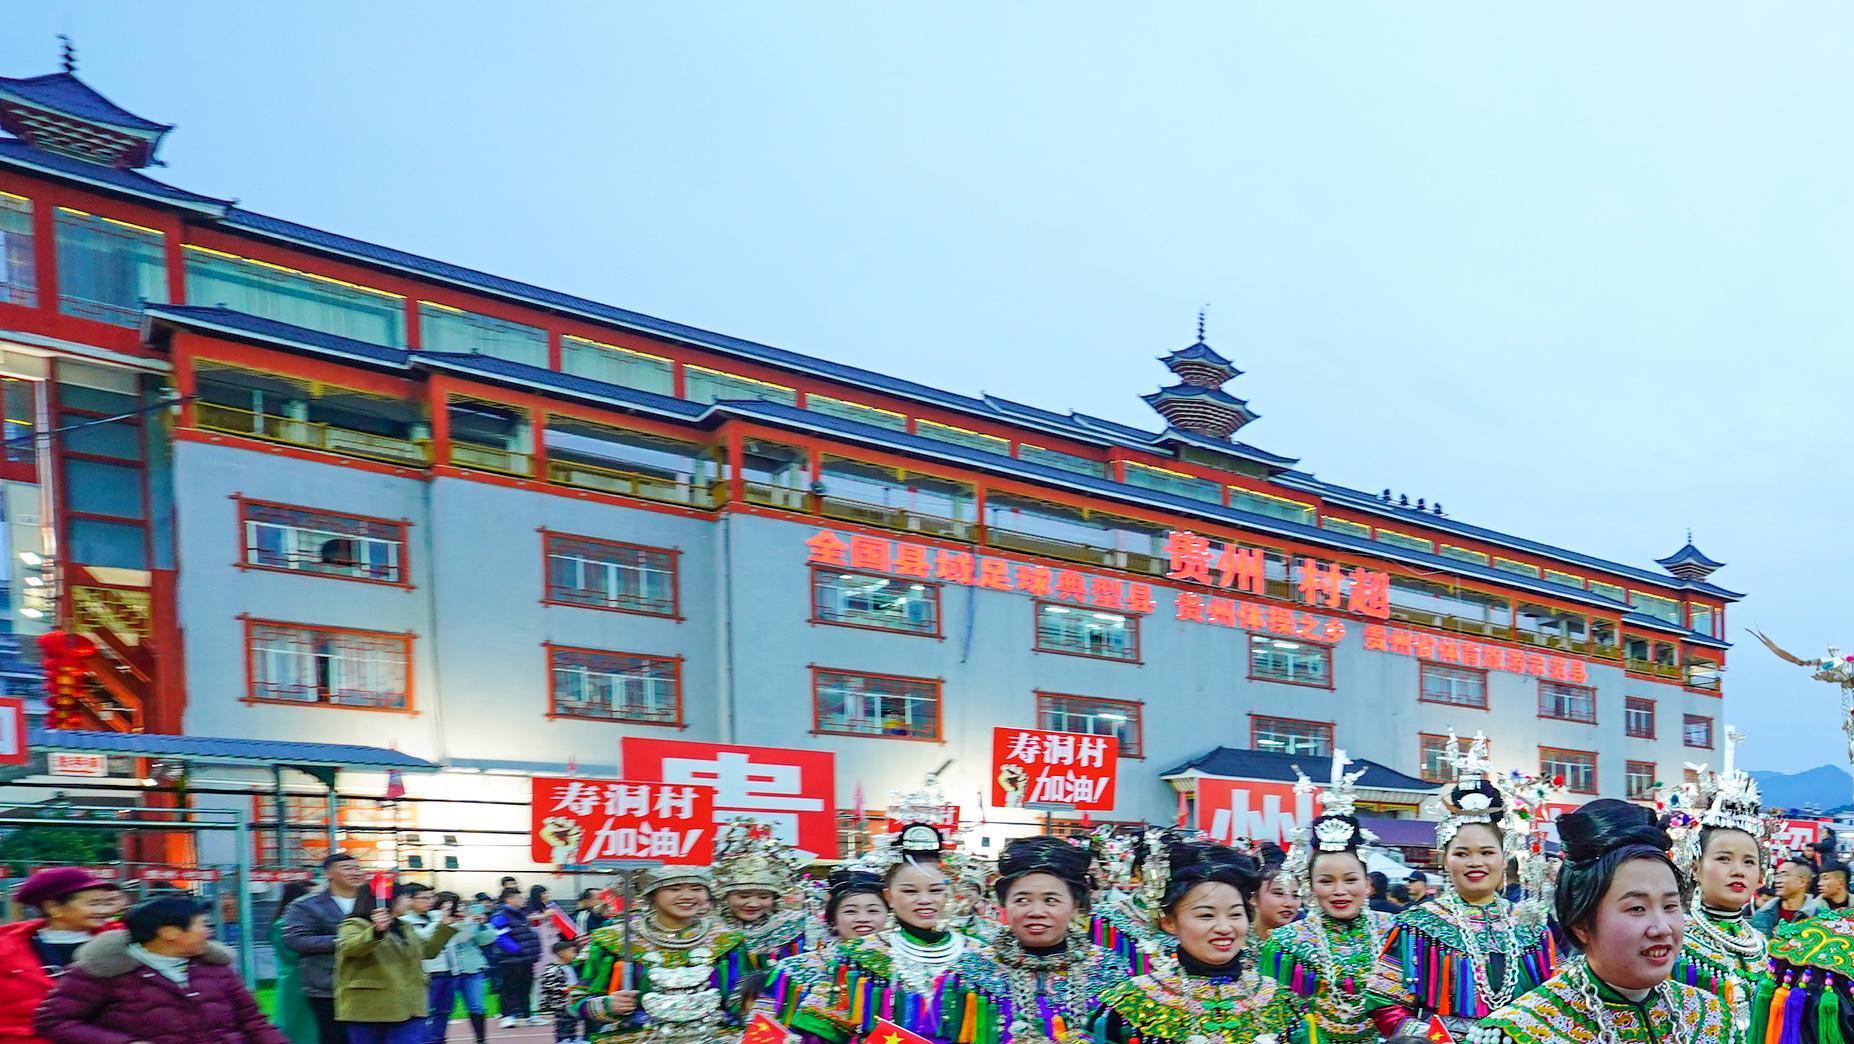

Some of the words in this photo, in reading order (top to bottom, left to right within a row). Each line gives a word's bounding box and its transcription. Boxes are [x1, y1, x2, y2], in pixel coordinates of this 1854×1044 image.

[805, 530, 1156, 614] 全国县域足球典型县
[1164, 530, 1264, 595] 贵州
[1299, 558, 1390, 619] 村超
[1006, 732, 1107, 768] 寿洞村
[550, 781, 700, 818] 寿洞村
[1028, 765, 1109, 803] 加油!
[582, 817, 704, 862] 加油!
